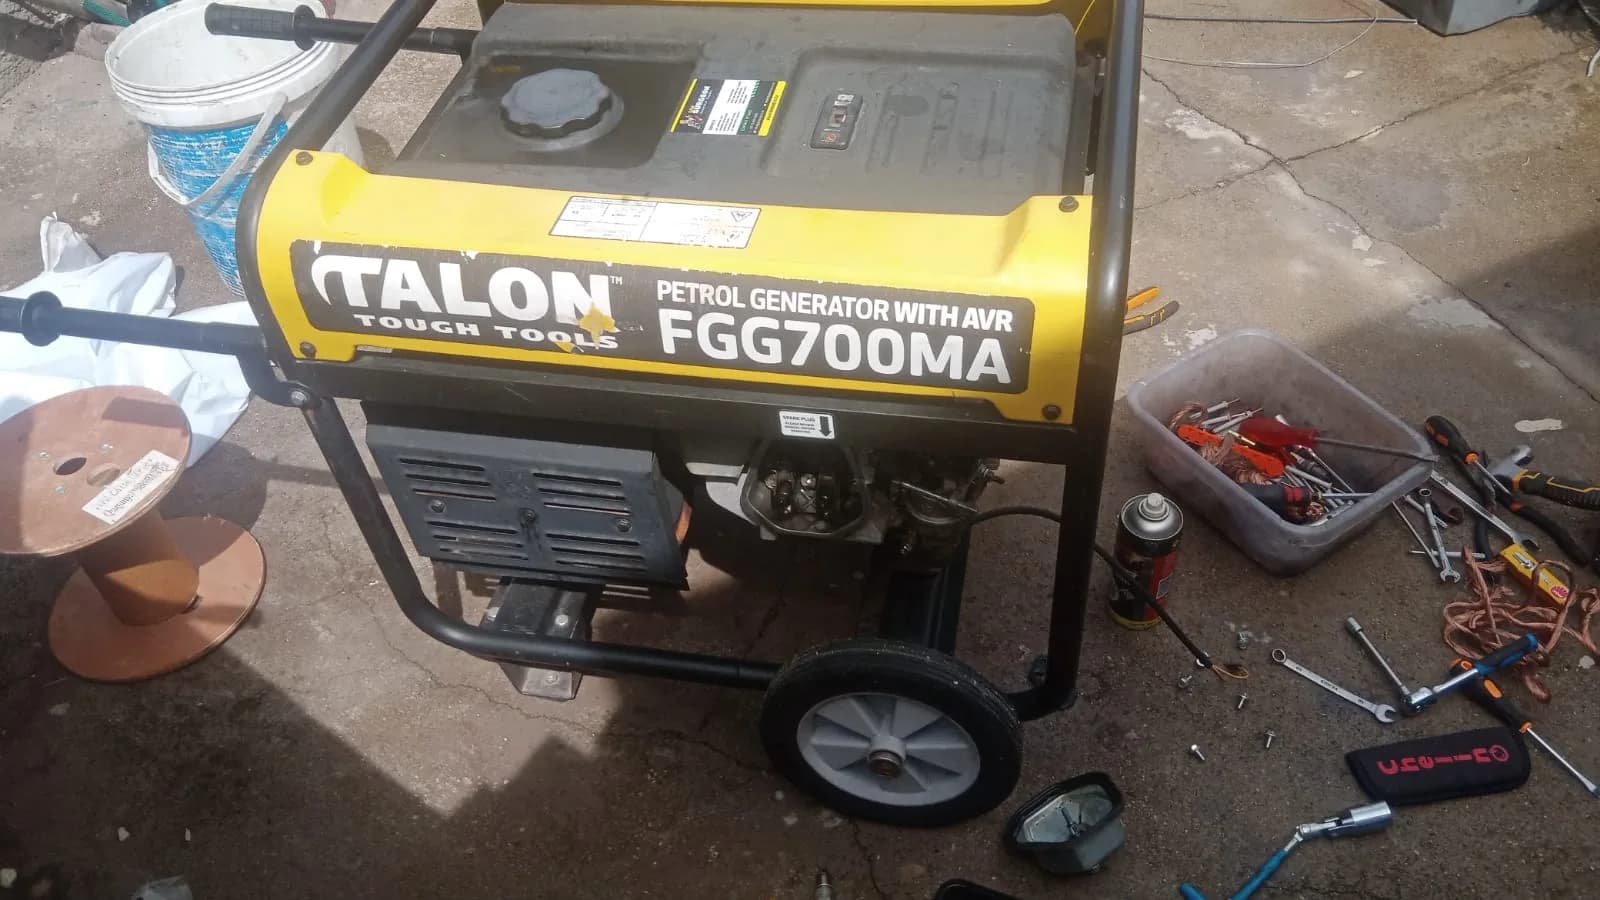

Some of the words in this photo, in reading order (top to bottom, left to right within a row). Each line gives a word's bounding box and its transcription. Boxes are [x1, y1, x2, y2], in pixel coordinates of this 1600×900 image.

[311, 254, 613, 327] TALON
[656, 279, 746, 308] PETROL
[749, 287, 890, 322] GENERATOR
[893, 301, 958, 328] WITH
[961, 306, 1013, 333] AVR
[352, 313, 480, 337] TOUGH
[493, 325, 618, 349] TOOLS
[658, 308, 1012, 384] FGG700MA
